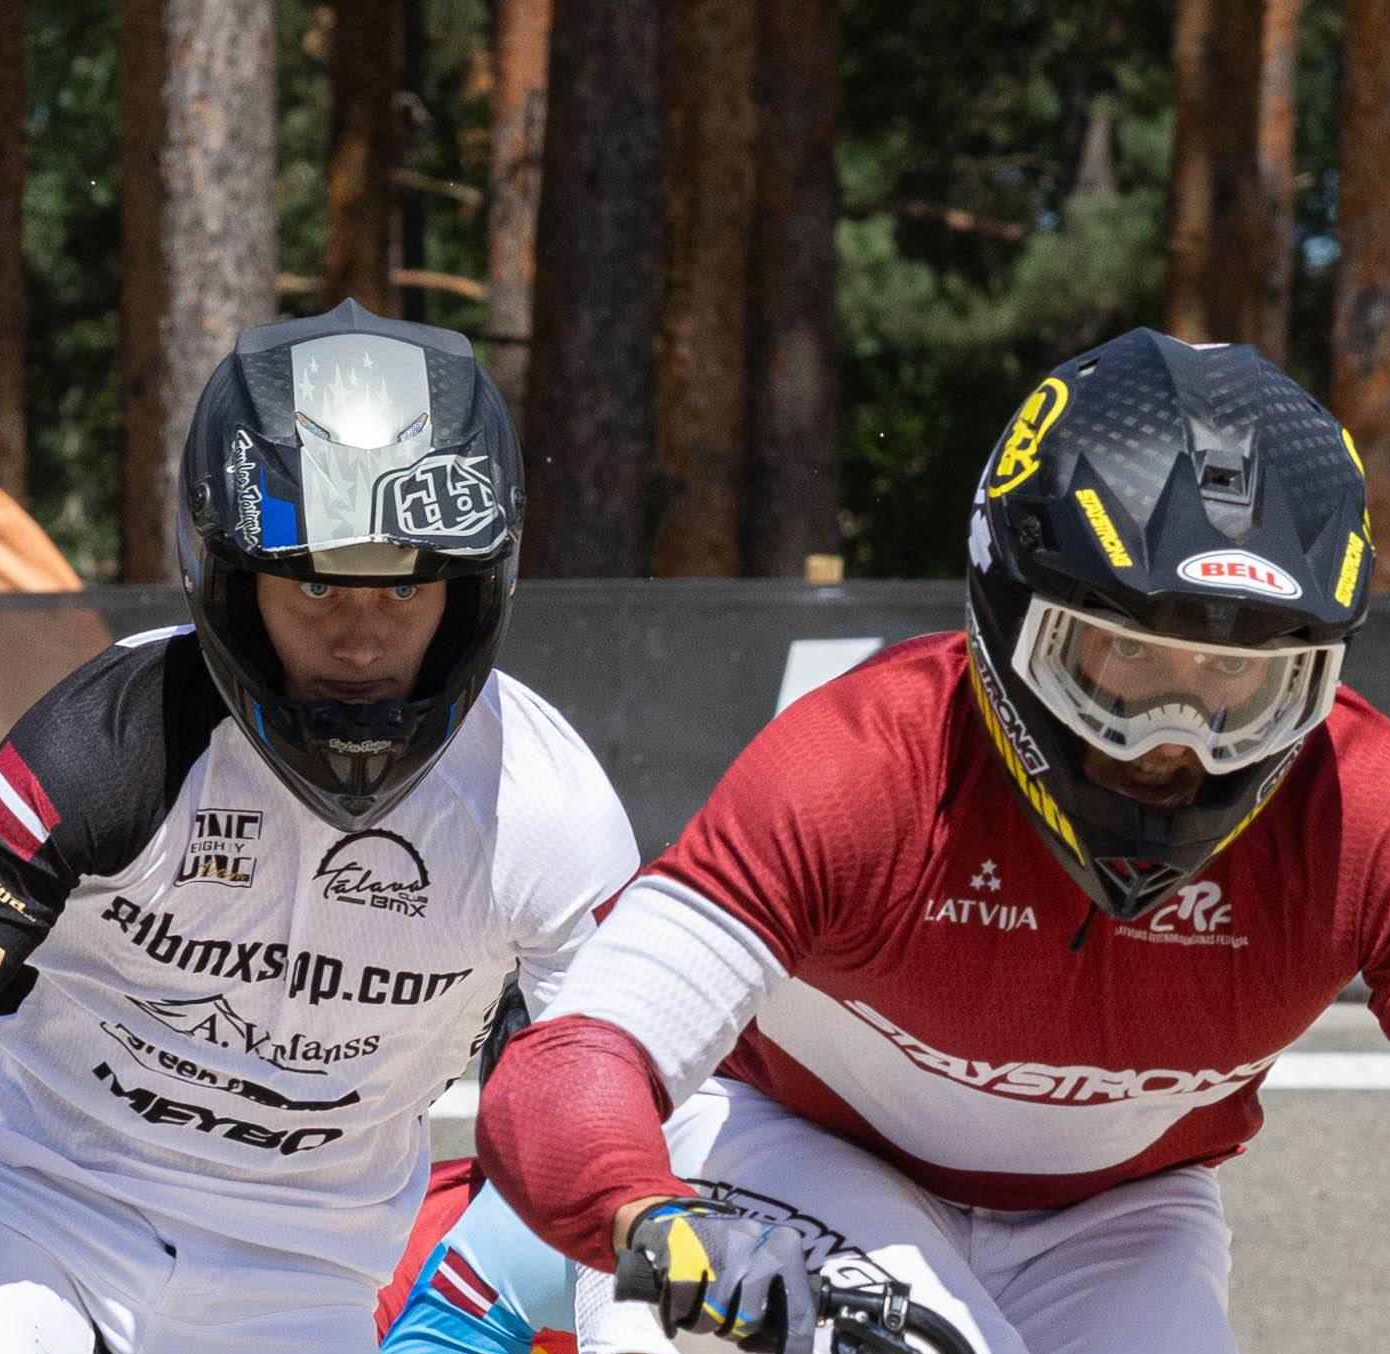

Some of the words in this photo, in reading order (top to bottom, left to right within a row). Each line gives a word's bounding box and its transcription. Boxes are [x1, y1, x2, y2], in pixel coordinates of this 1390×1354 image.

[1200, 561, 1284, 591] BELL
[369, 894, 428, 918] BMX
[923, 897, 1039, 932] LATVIJA
[92, 1061, 343, 1156] MEYBO
